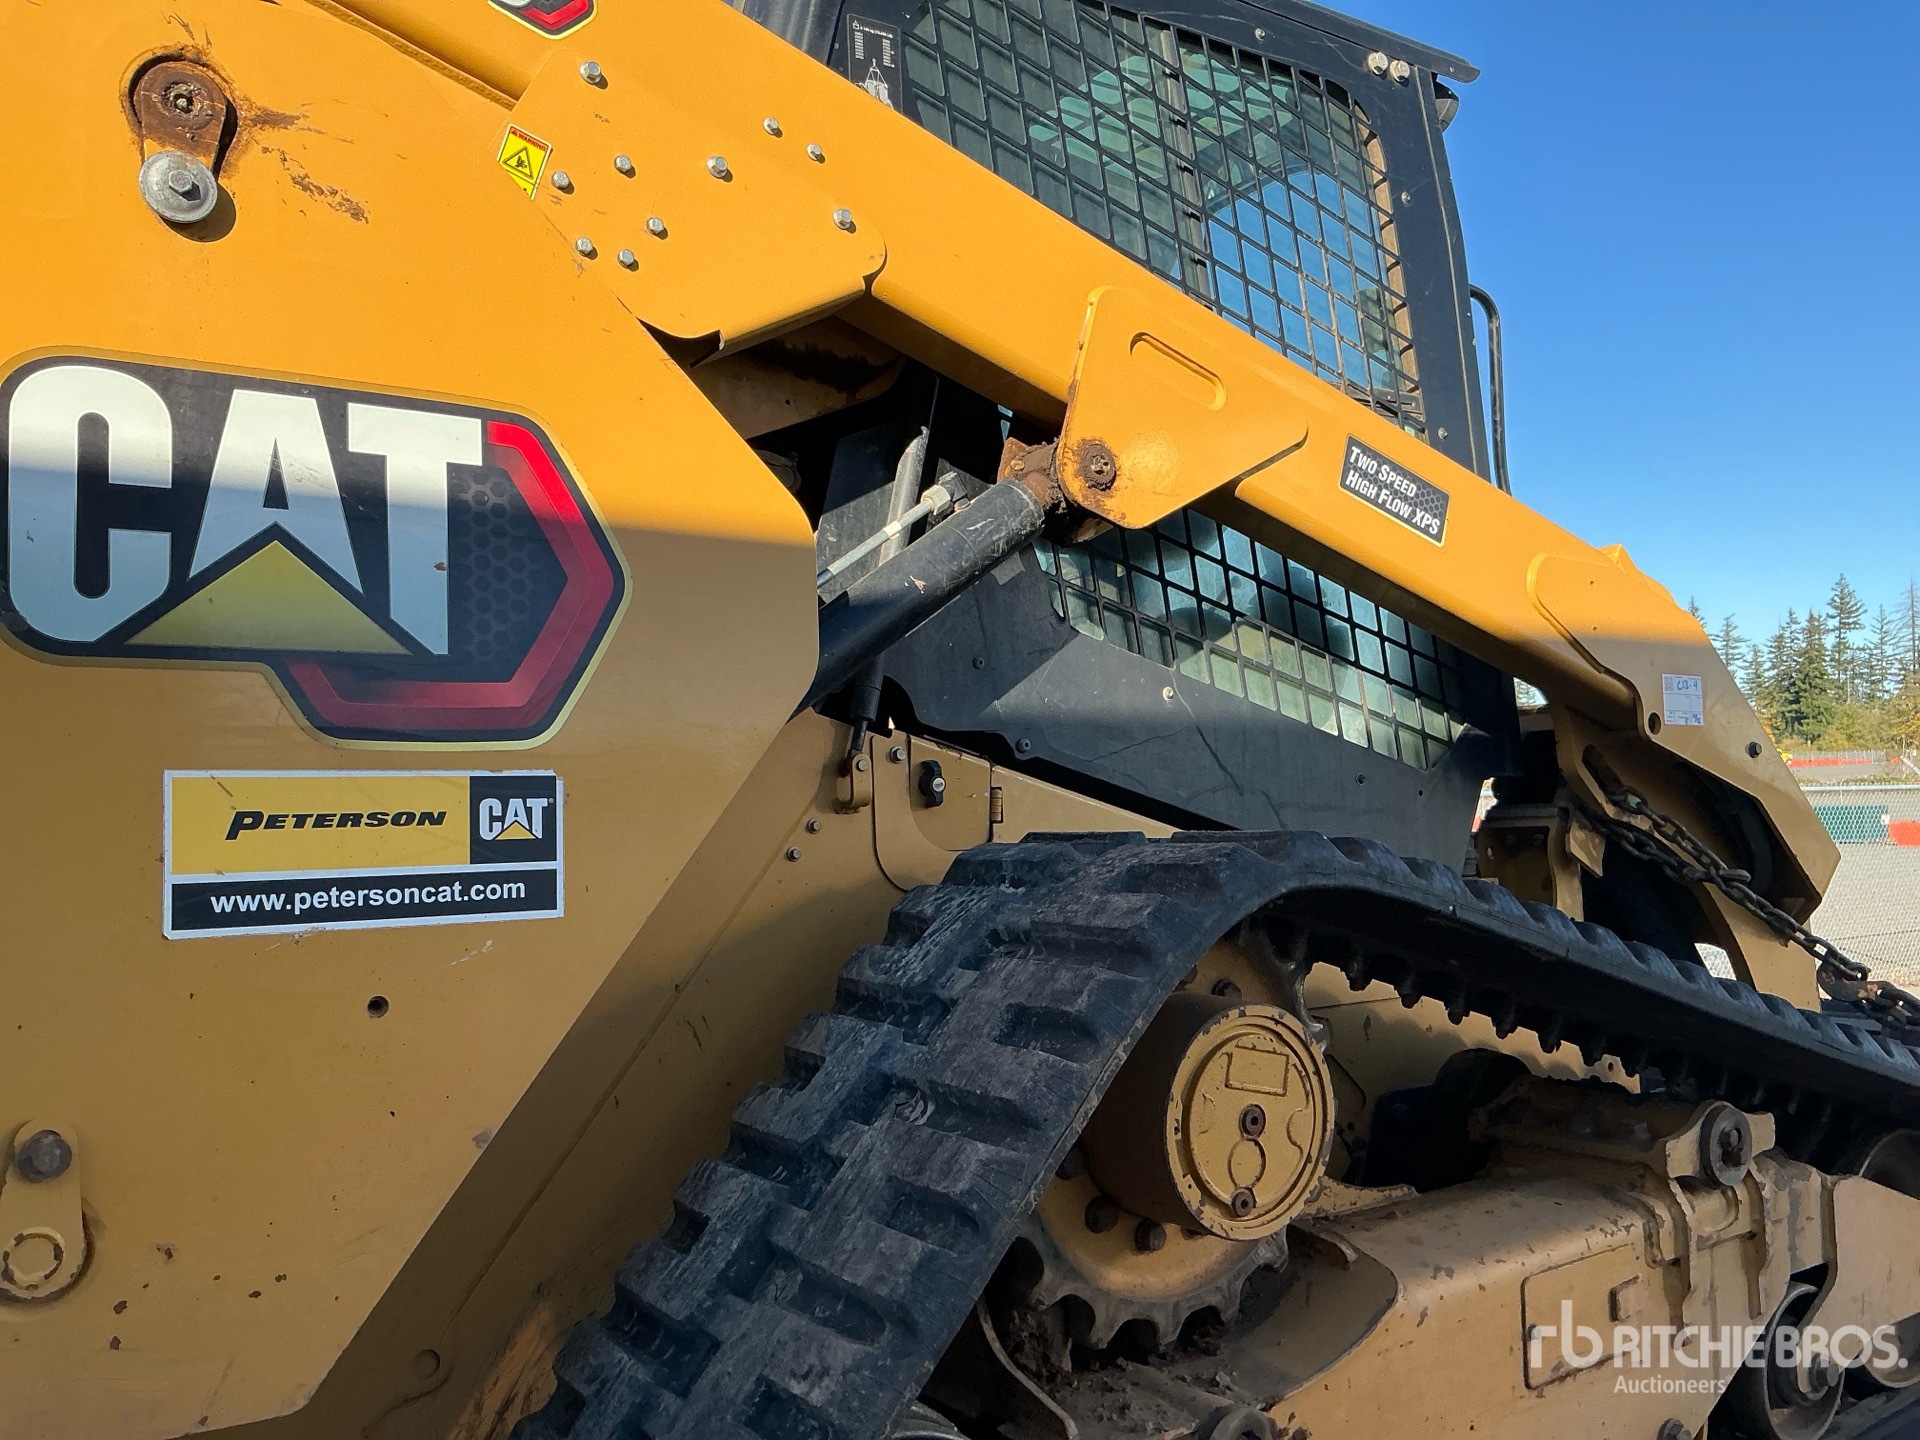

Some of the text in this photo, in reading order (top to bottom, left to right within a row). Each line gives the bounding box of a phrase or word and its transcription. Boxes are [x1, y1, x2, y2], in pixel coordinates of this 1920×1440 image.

[518, 133, 546, 151] WARNING
[8, 364, 483, 656] CAT
[1412, 508, 1441, 535] XPS
[224, 797, 550, 842] PETERSON CAT
[210, 880, 527, 916] www.petersoncat.com
